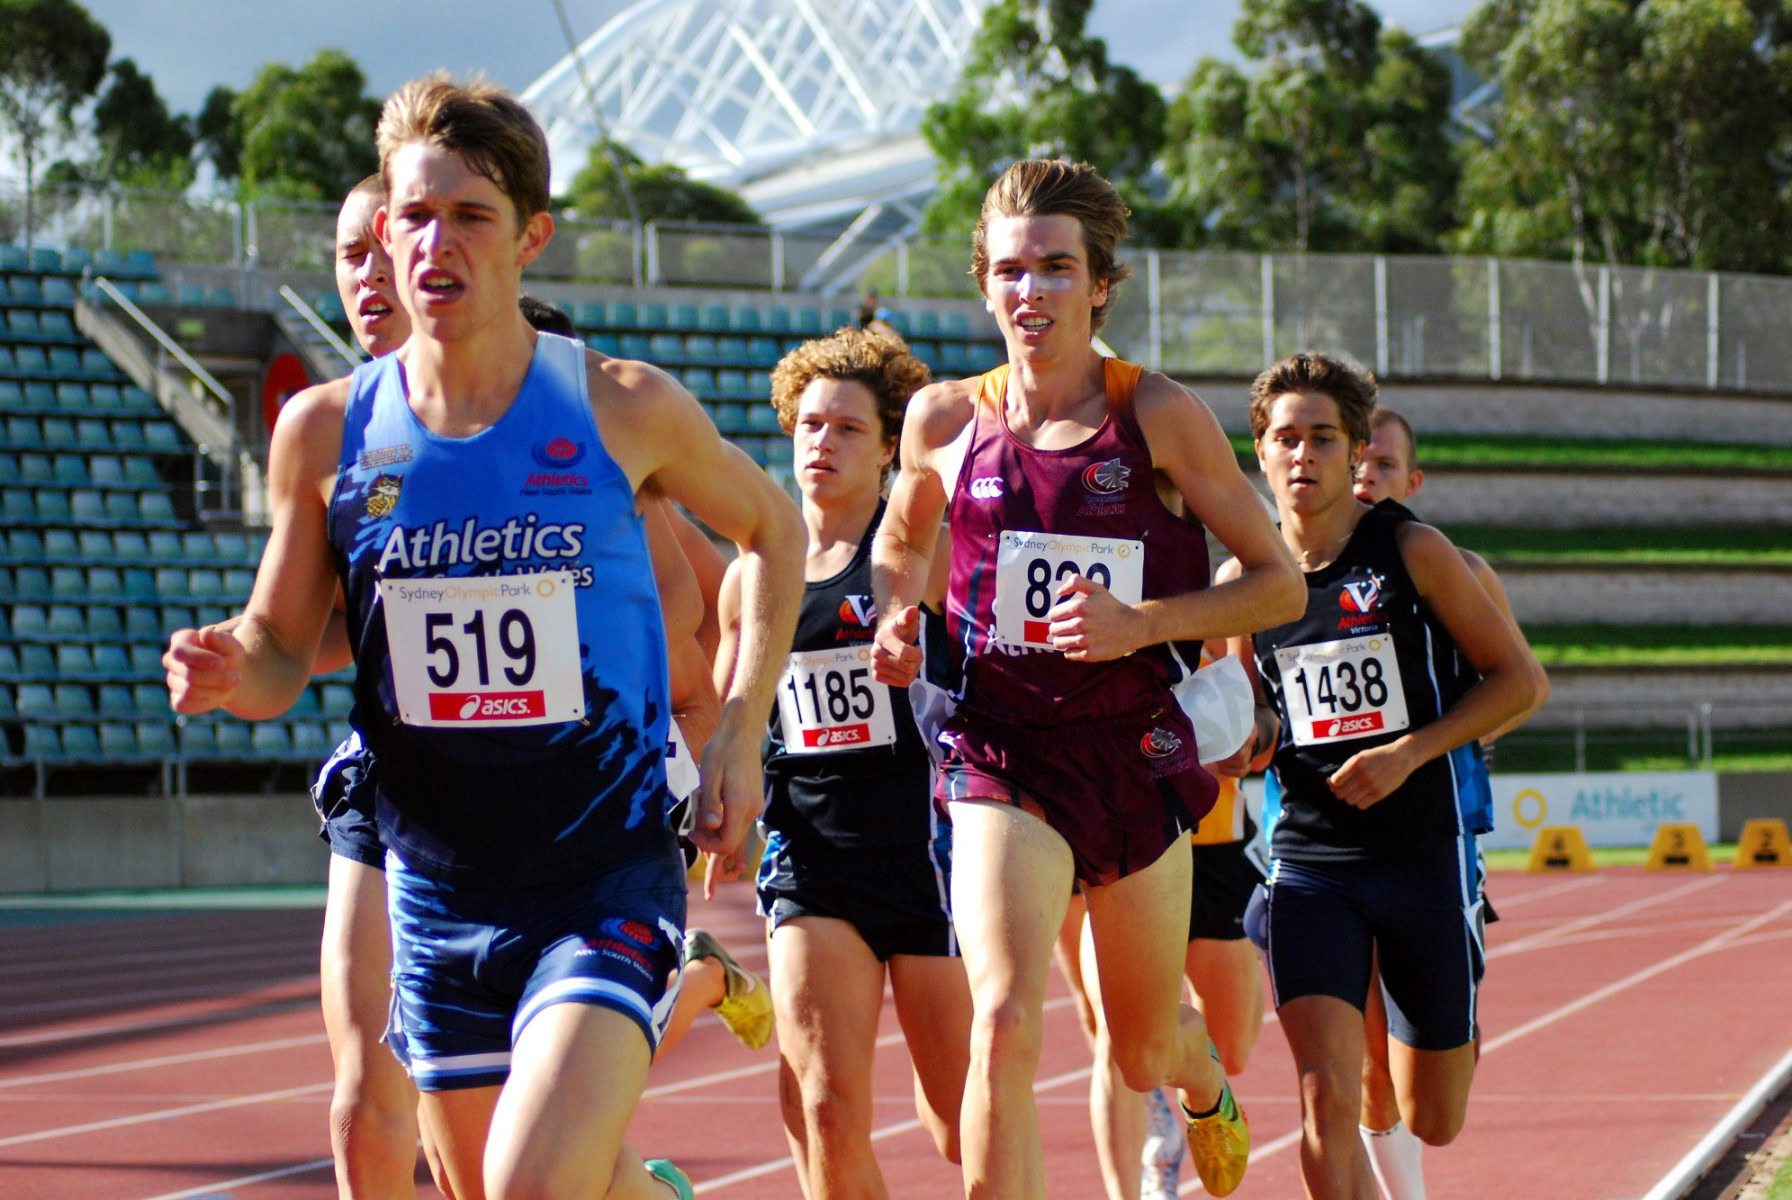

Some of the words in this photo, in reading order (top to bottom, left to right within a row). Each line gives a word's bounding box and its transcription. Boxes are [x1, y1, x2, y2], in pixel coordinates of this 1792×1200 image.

[378, 515, 584, 572] Athletics
[425, 608, 536, 688] 519
[788, 668, 874, 723] 1185
[1295, 657, 1388, 716] 1438
[1570, 787, 1684, 819] Athletic
[602, 949, 632, 965] South
